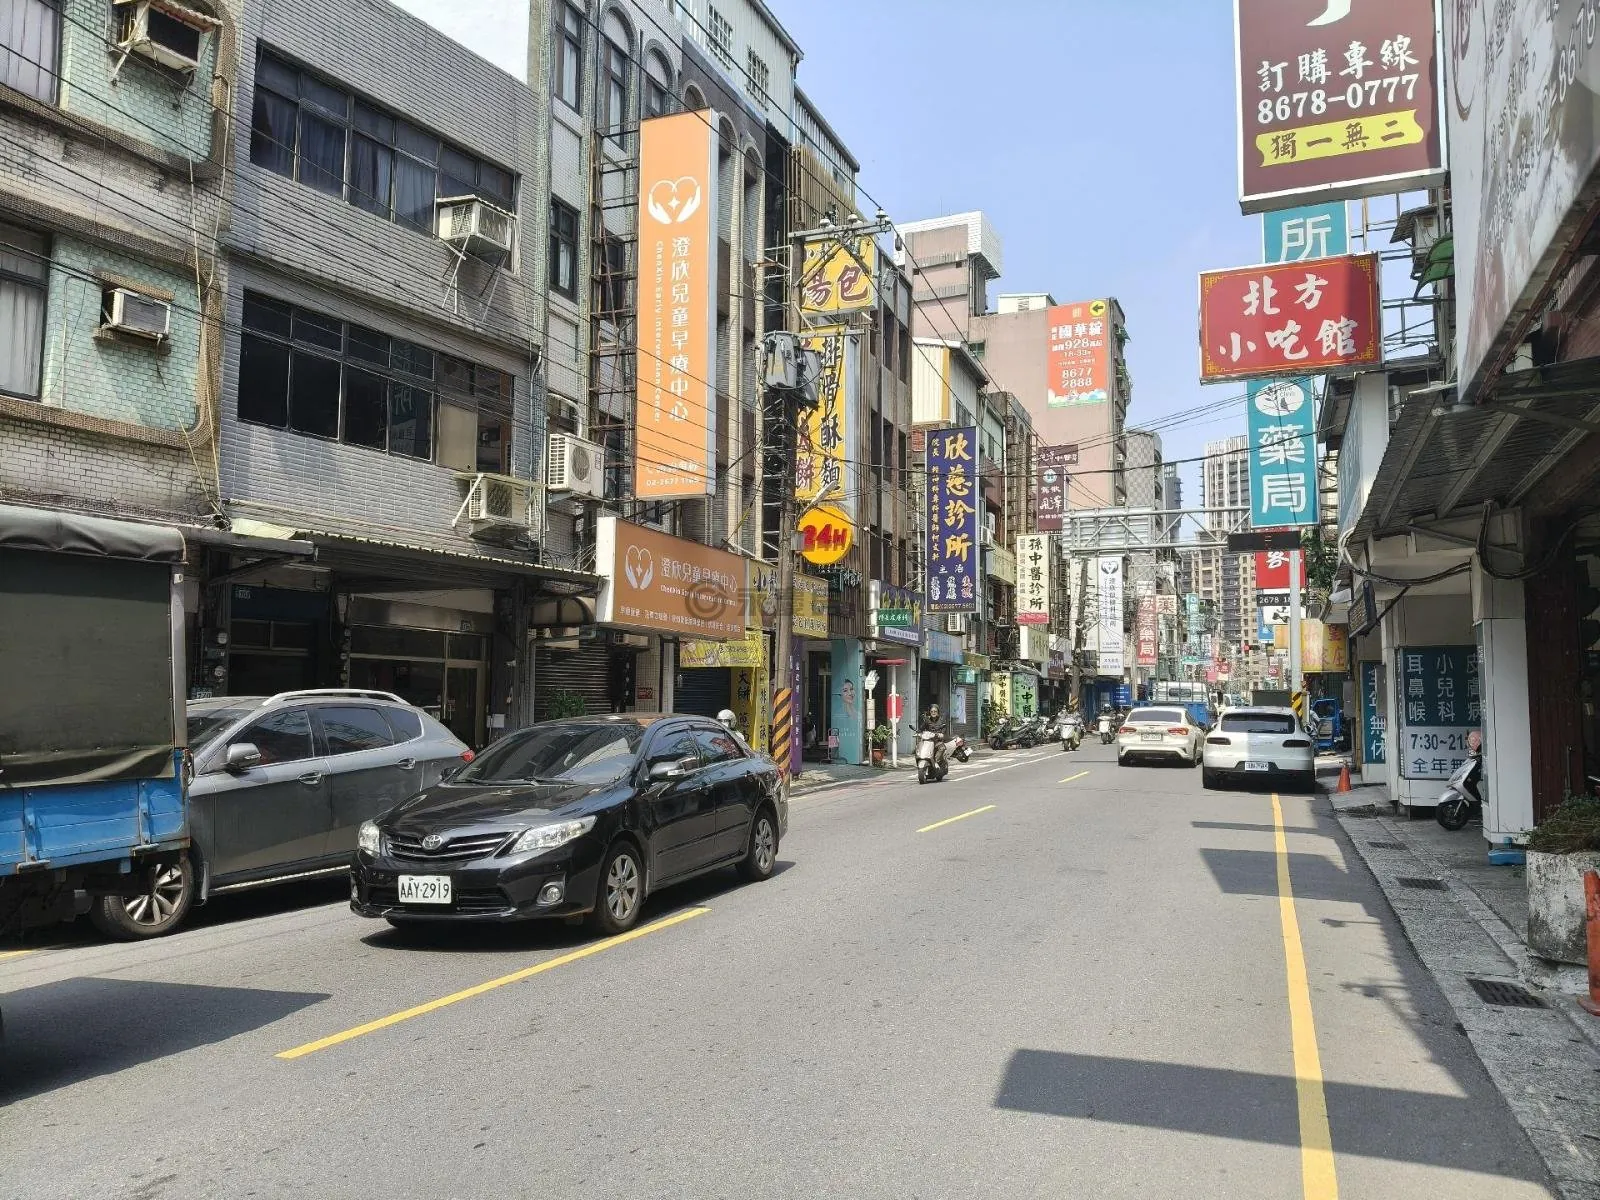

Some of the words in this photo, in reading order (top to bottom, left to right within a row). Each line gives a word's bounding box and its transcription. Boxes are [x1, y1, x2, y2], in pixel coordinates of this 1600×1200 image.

[1256, 35, 1420, 93] 訂購專線
[1257, 74, 1420, 124] 8678-0777
[1270, 120, 1406, 160] 獨一無二
[1280, 213, 1333, 261] 所
[1243, 273, 1329, 316] 北方
[671, 236, 691, 421] 澄欣兒童早療中心
[1219, 315, 1358, 362] 小吃館
[1259, 424, 1306, 513] 藥局
[944, 432, 976, 562] 欣慈診所
[803, 524, 848, 551] 24H
[1028, 537, 1045, 610] 孫中醫診所
[1407, 654, 1426, 722] 耳鼻喉
[1436, 653, 1456, 722] 小兒科
[401, 881, 450, 899] AAY-2919
